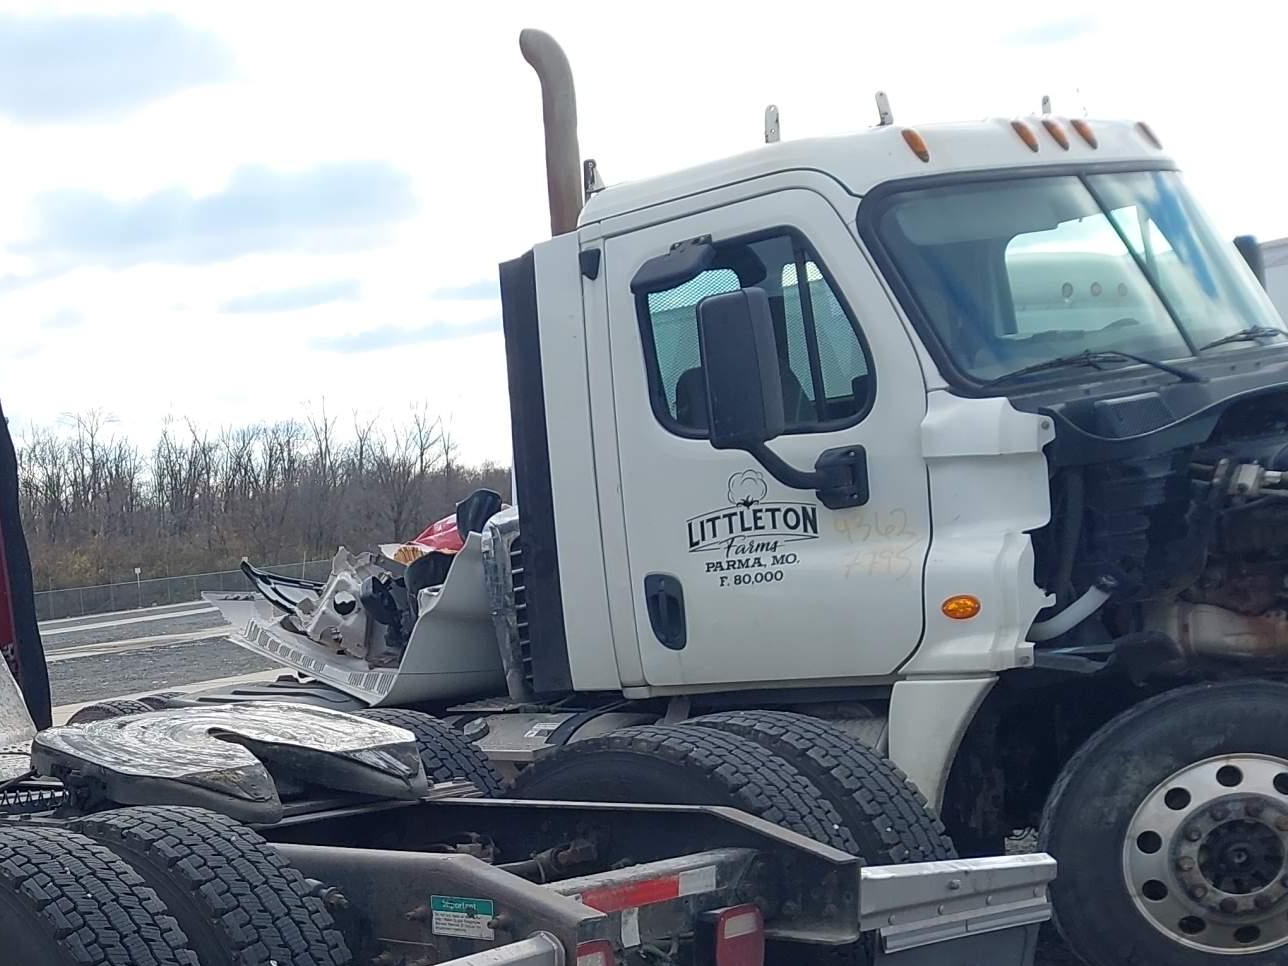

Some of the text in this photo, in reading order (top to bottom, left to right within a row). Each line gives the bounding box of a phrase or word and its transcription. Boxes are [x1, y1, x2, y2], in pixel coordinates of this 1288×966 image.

[687, 506, 819, 549] LITTLETON
[720, 535, 779, 559] Farms
[705, 553, 801, 573] PARMA, MO.
[720, 570, 784, 587] F. 80,000
